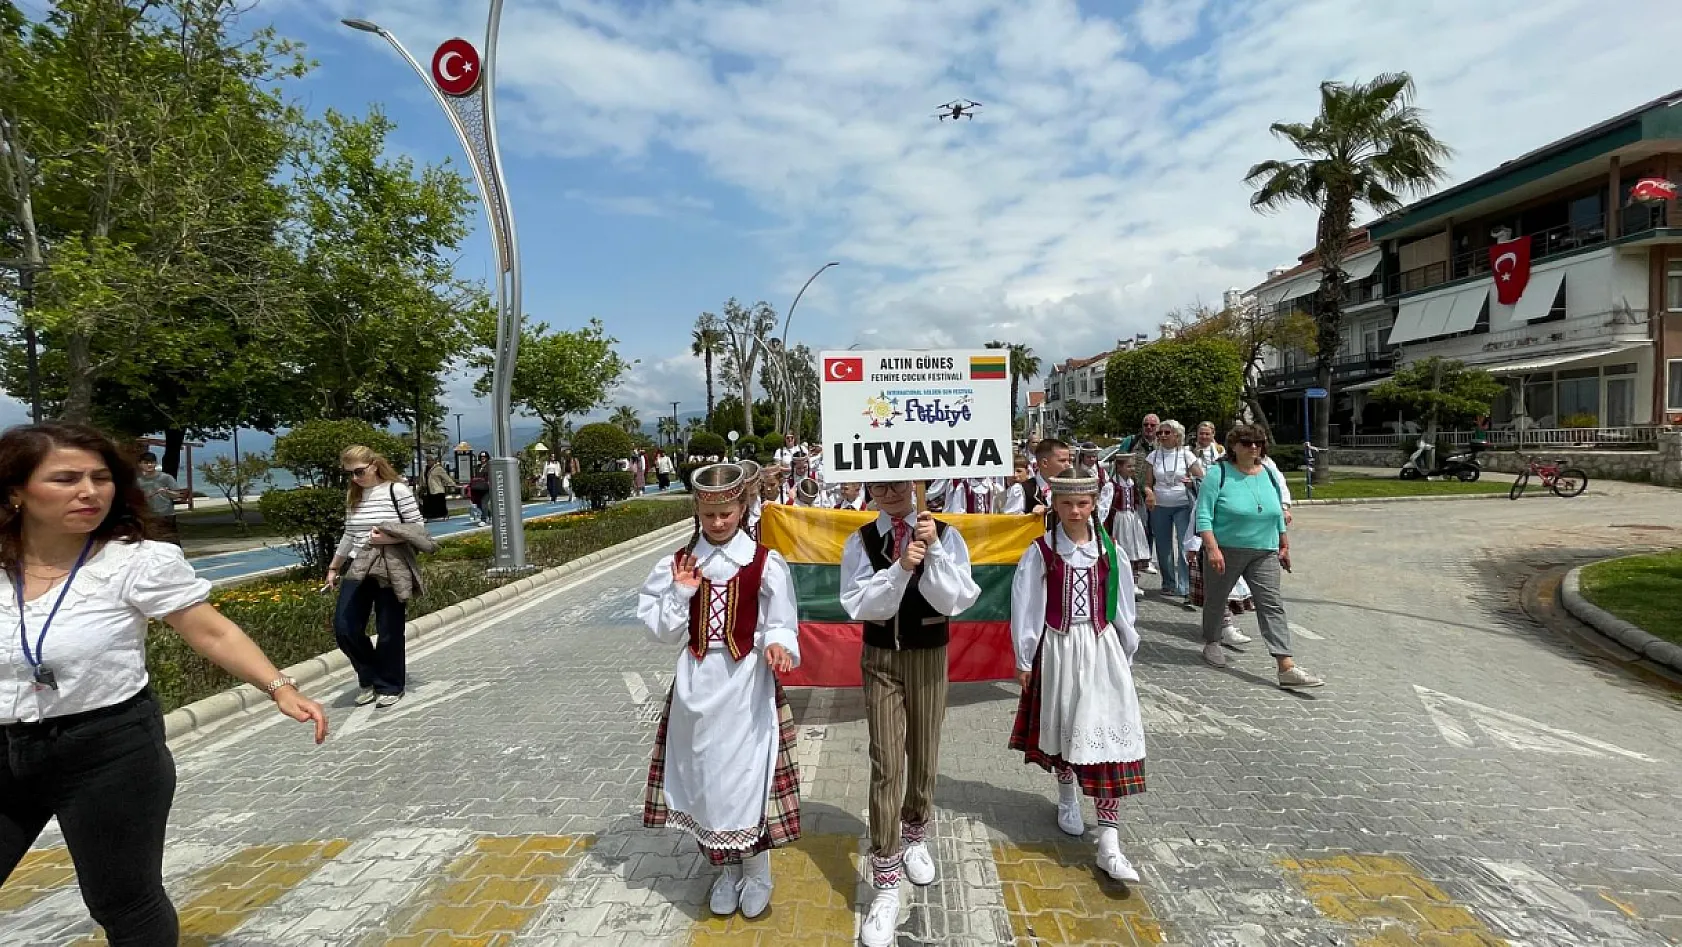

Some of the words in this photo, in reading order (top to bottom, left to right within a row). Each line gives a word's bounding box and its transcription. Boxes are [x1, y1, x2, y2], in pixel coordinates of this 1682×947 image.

[880, 357, 912, 370] ALTIN
[916, 355, 954, 370] GÜNEŞ
[833, 433, 1003, 471] LİTVANYA
